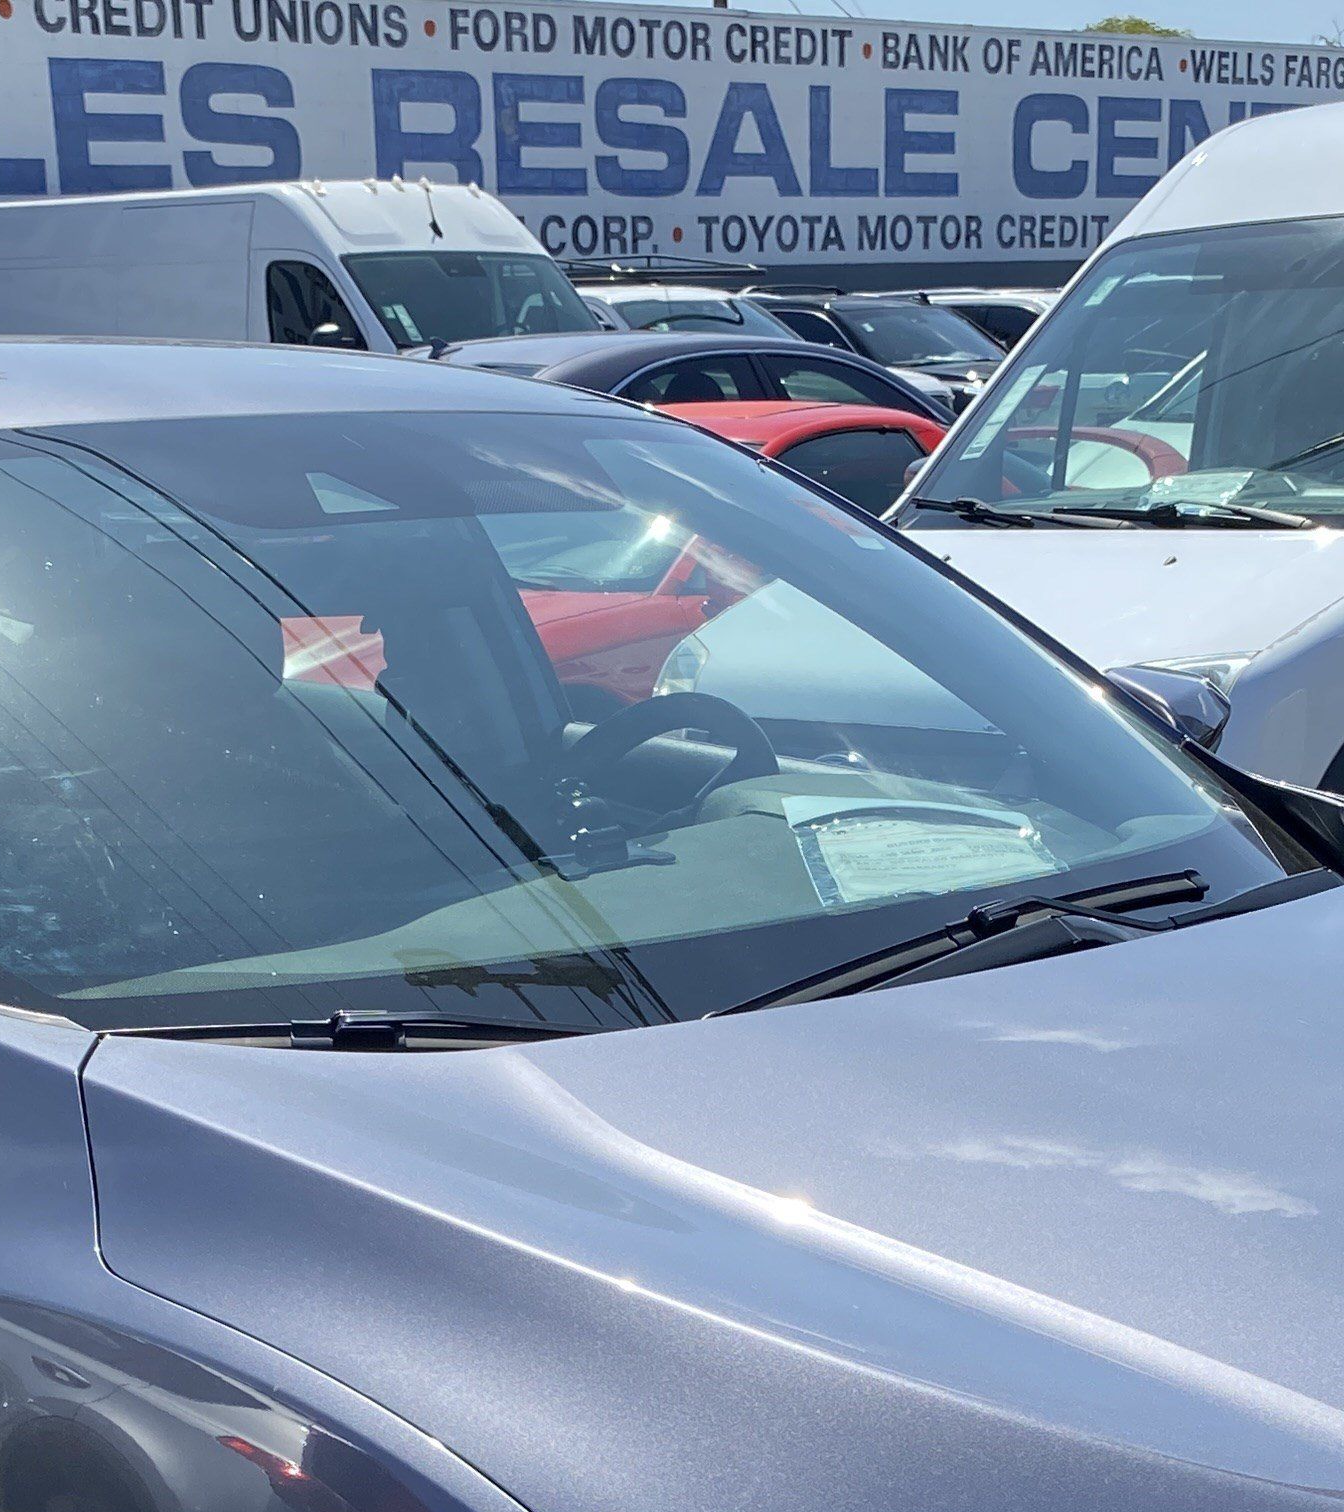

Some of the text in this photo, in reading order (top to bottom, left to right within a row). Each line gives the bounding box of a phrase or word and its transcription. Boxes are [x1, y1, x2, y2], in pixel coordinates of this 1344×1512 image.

[34, 0, 213, 40] CREDIT
[233, 0, 408, 48] UNIONS
[450, 9, 557, 53] FORD
[573, 15, 712, 61] MOTOR
[725, 24, 853, 67] CREDIT
[881, 32, 971, 72] BANK
[983, 37, 1022, 75] OF
[1029, 41, 1165, 81] AMERICA
[1190, 50, 1275, 86] WELLS
[371, 67, 961, 198] RESALE
[540, 214, 659, 256] CORP.
[698, 214, 846, 253] TOYOTA
[857, 214, 983, 251] MOTOR
[995, 214, 1110, 250] CREDIT
